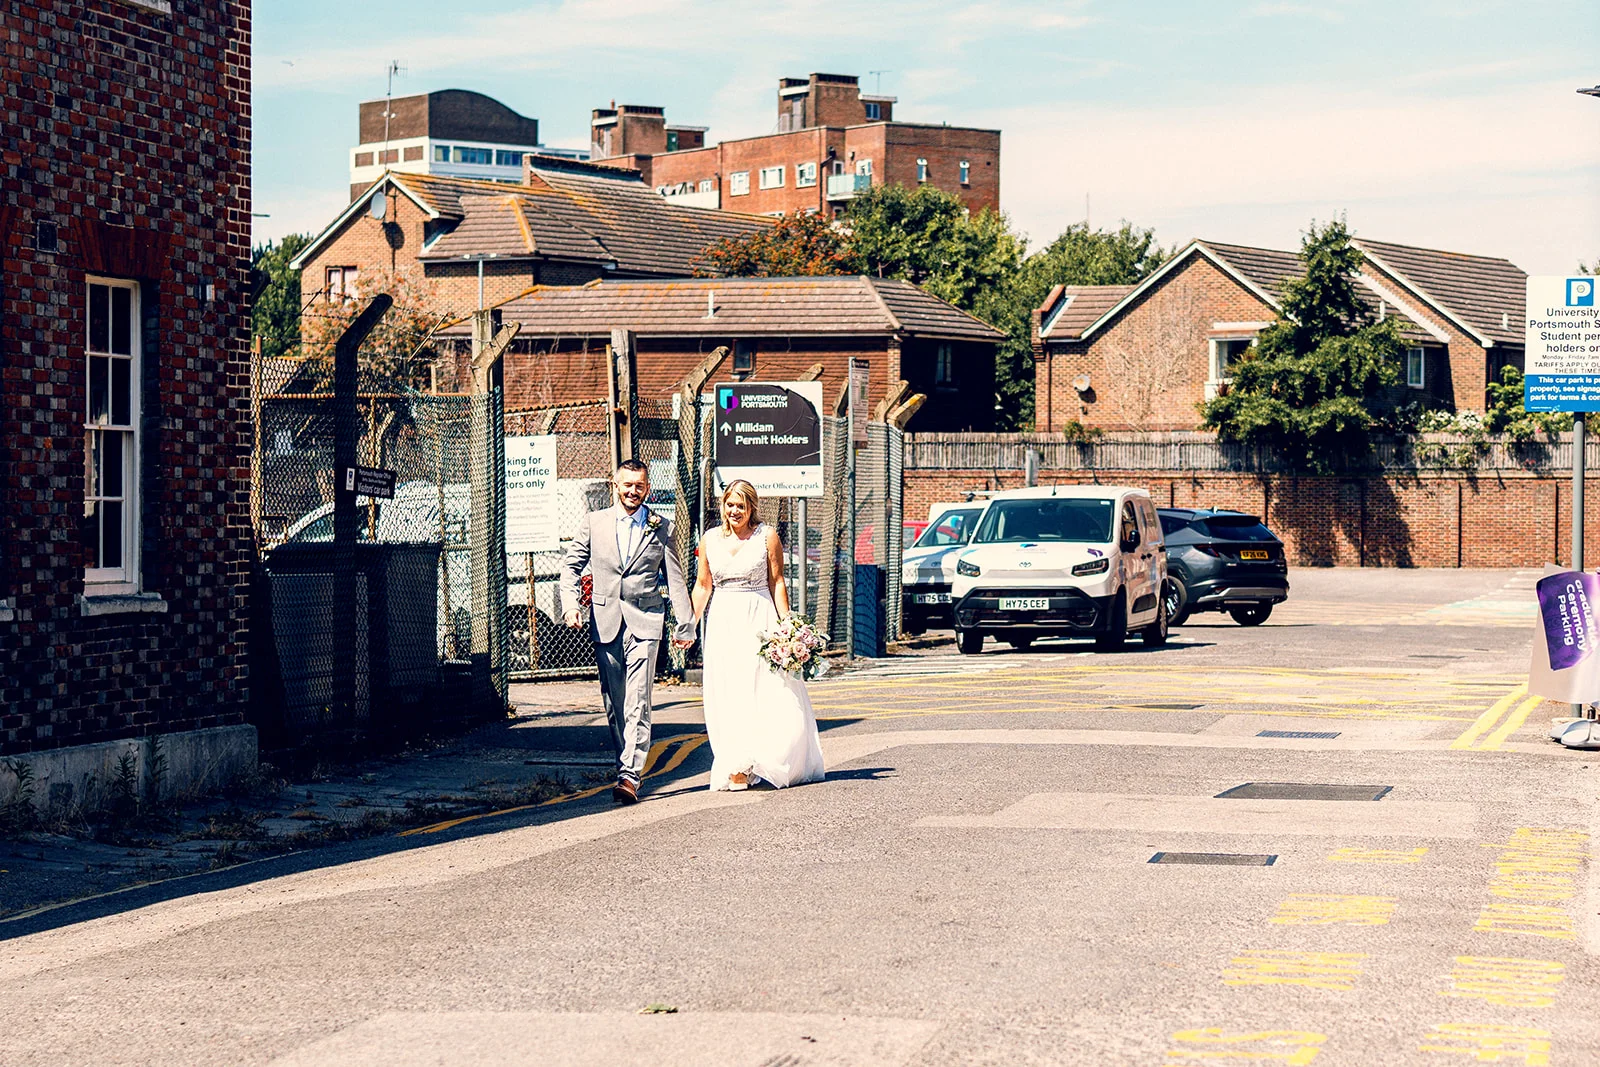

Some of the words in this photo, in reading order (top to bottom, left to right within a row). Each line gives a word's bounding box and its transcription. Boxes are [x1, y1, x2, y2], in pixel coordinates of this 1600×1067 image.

[1546, 308, 1600, 318] University
[1530, 320, 1590, 328] Portsmouth
[1541, 332, 1581, 340] Student
[1584, 333, 1600, 342] per
[1547, 344, 1586, 352] holders
[1577, 385, 1600, 393] signag
[735, 423, 774, 432] Milldam
[735, 435, 769, 445] Permit
[770, 435, 809, 445] Holders
[507, 457, 527, 467] king
[529, 456, 542, 464] for
[523, 467, 550, 476] office
[506, 481, 524, 489] tors
[526, 479, 545, 489] only
[804, 482, 819, 490] park
[1005, 600, 1028, 608] HY75
[1030, 600, 1046, 608] CEF
[1558, 594, 1574, 646] Parking
[1566, 583, 1587, 653] Ceremony
